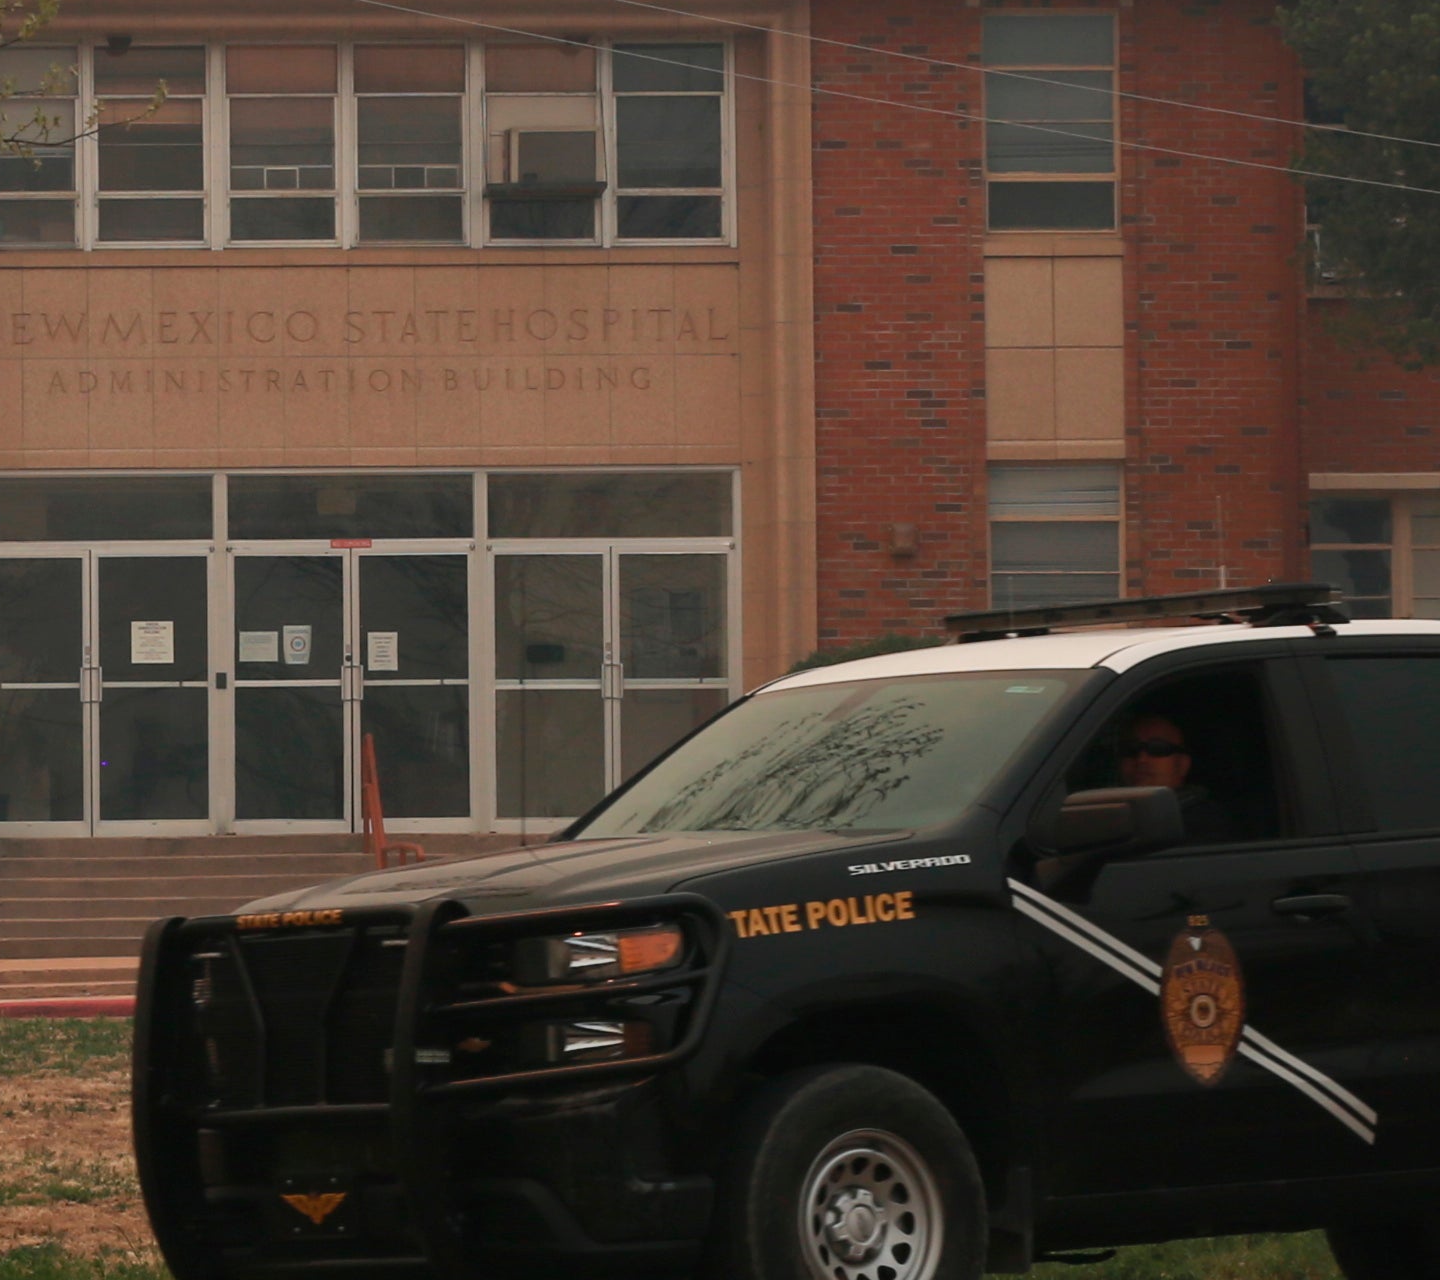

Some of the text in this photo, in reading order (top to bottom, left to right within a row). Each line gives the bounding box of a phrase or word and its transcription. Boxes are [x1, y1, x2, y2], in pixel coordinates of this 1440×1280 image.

[100, 310, 322, 345] MEXICO
[342, 309, 478, 344] STATE
[491, 307, 730, 344] HOSPITAL
[47, 365, 653, 396] ADMINISTRATION BUILDING
[848, 854, 971, 876] SILVERADO
[236, 909, 344, 930] STATE POLICE
[725, 890, 916, 938] TATE POLICE
